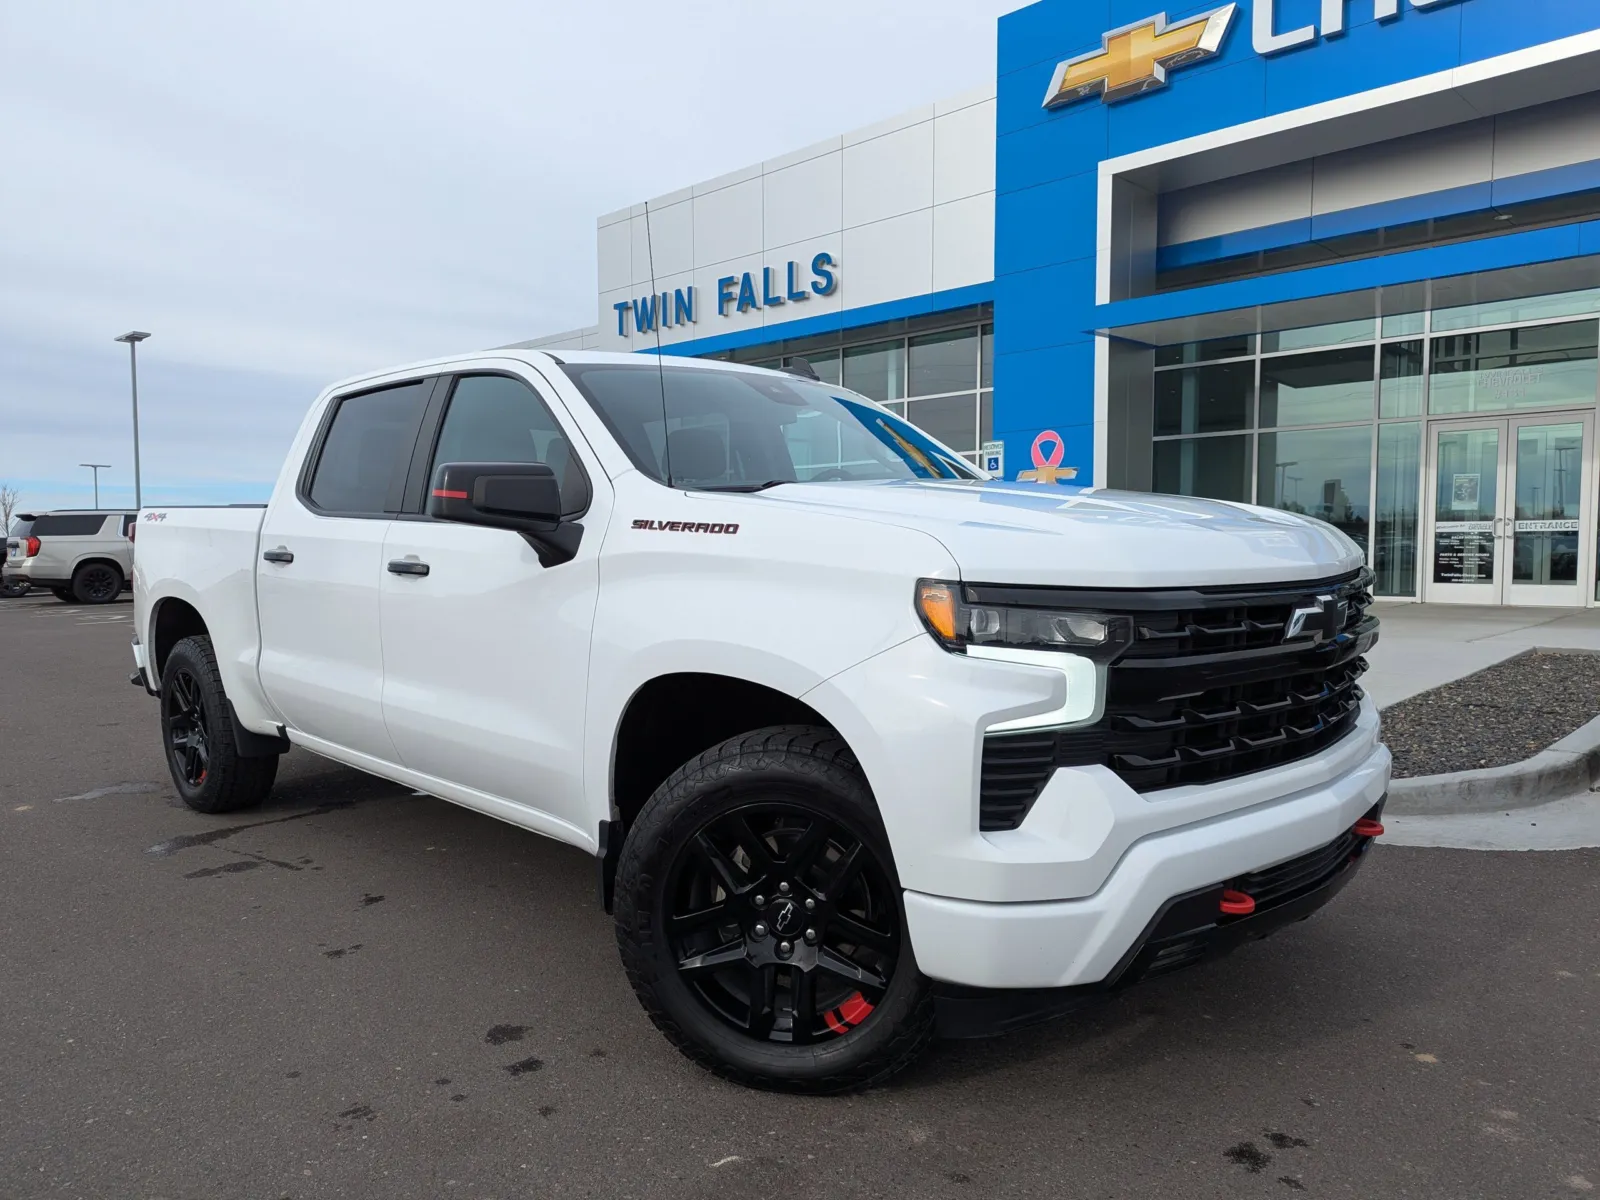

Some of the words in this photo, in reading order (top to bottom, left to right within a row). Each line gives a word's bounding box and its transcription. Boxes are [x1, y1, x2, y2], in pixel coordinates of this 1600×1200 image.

[613, 285, 697, 337] TWIN
[717, 252, 838, 317] FALLS
[631, 519, 740, 535] SILVERADO
[1518, 521, 1578, 530] ENTRANCE
